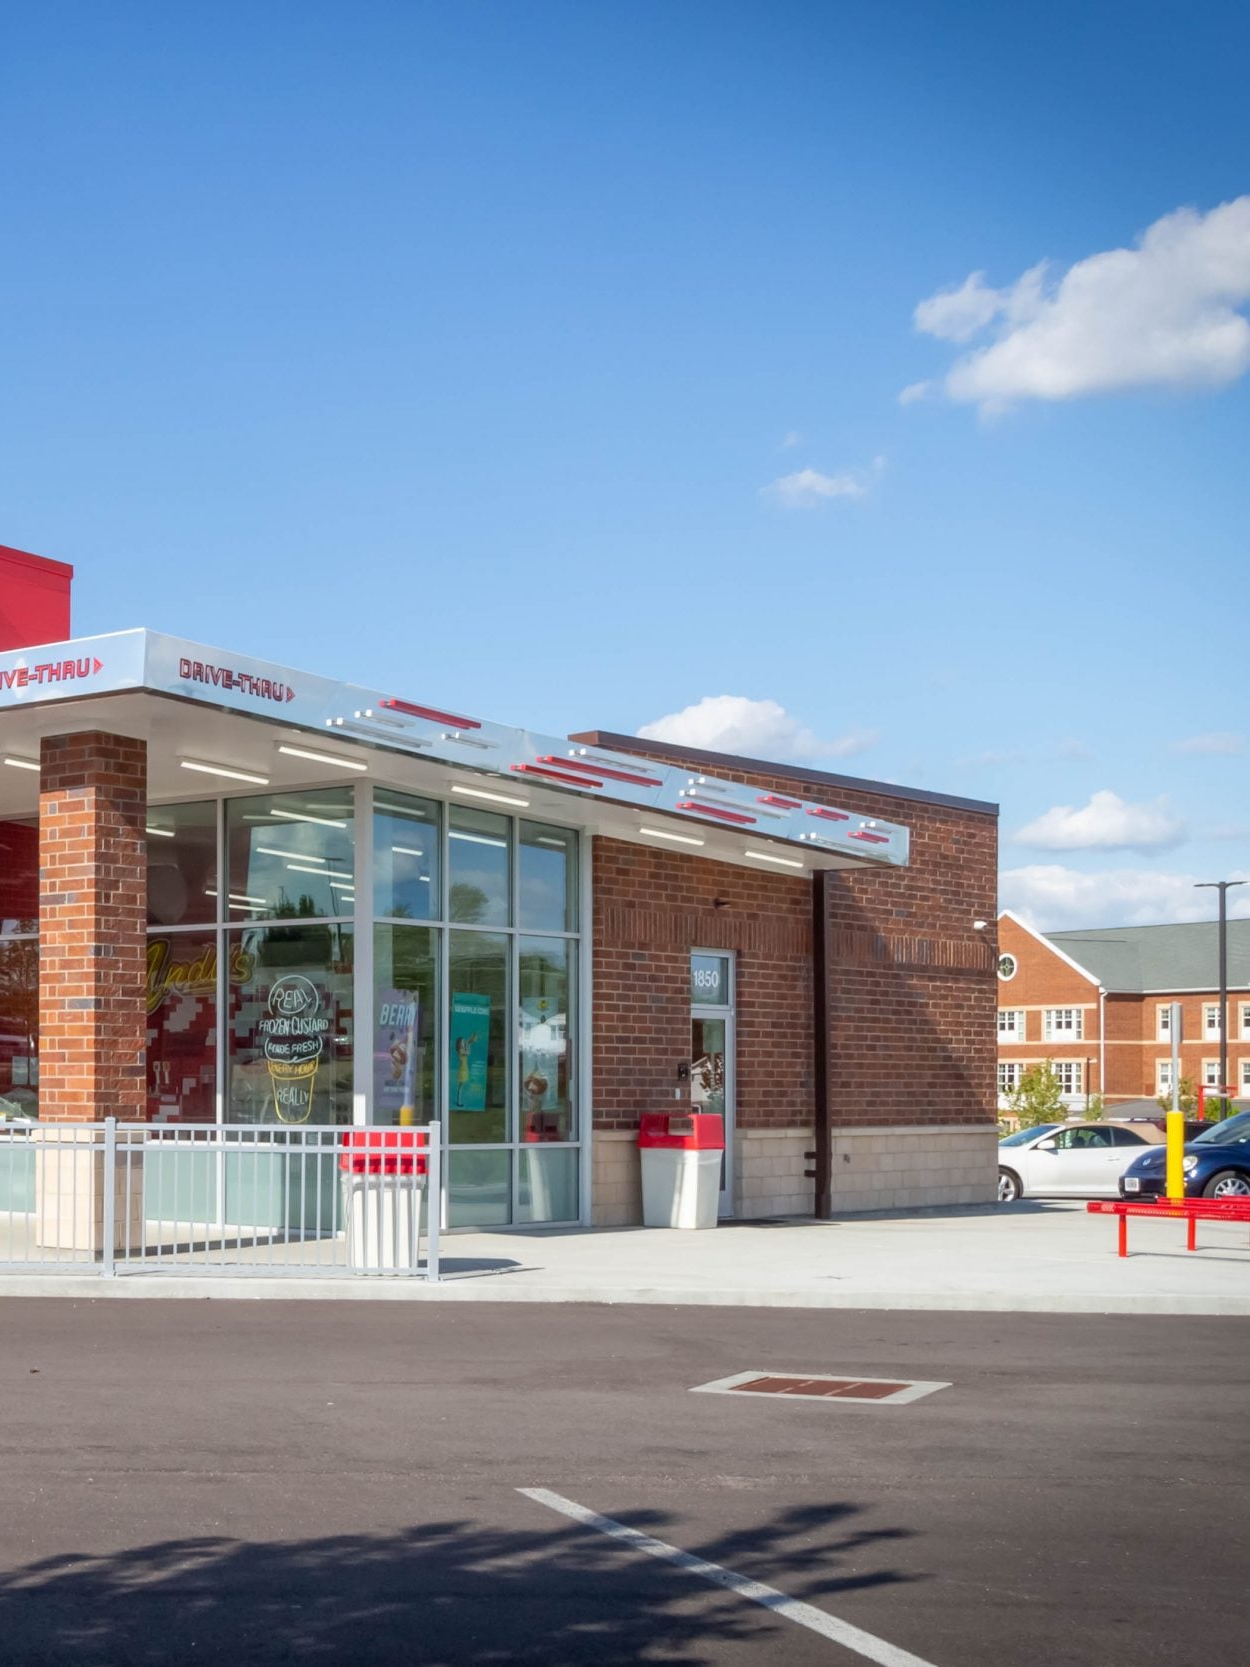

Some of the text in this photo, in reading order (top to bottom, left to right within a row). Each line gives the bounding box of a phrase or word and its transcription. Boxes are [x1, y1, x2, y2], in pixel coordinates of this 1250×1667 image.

[179, 658, 284, 702] DRIVE-THRU
[693, 969, 719, 988] 1850
[272, 987, 313, 1014] REAL
[258, 1016, 329, 1036] FROZEN CUSTARD
[291, 1041, 319, 1053] FRESH
[276, 1086, 310, 1106] REALLY
